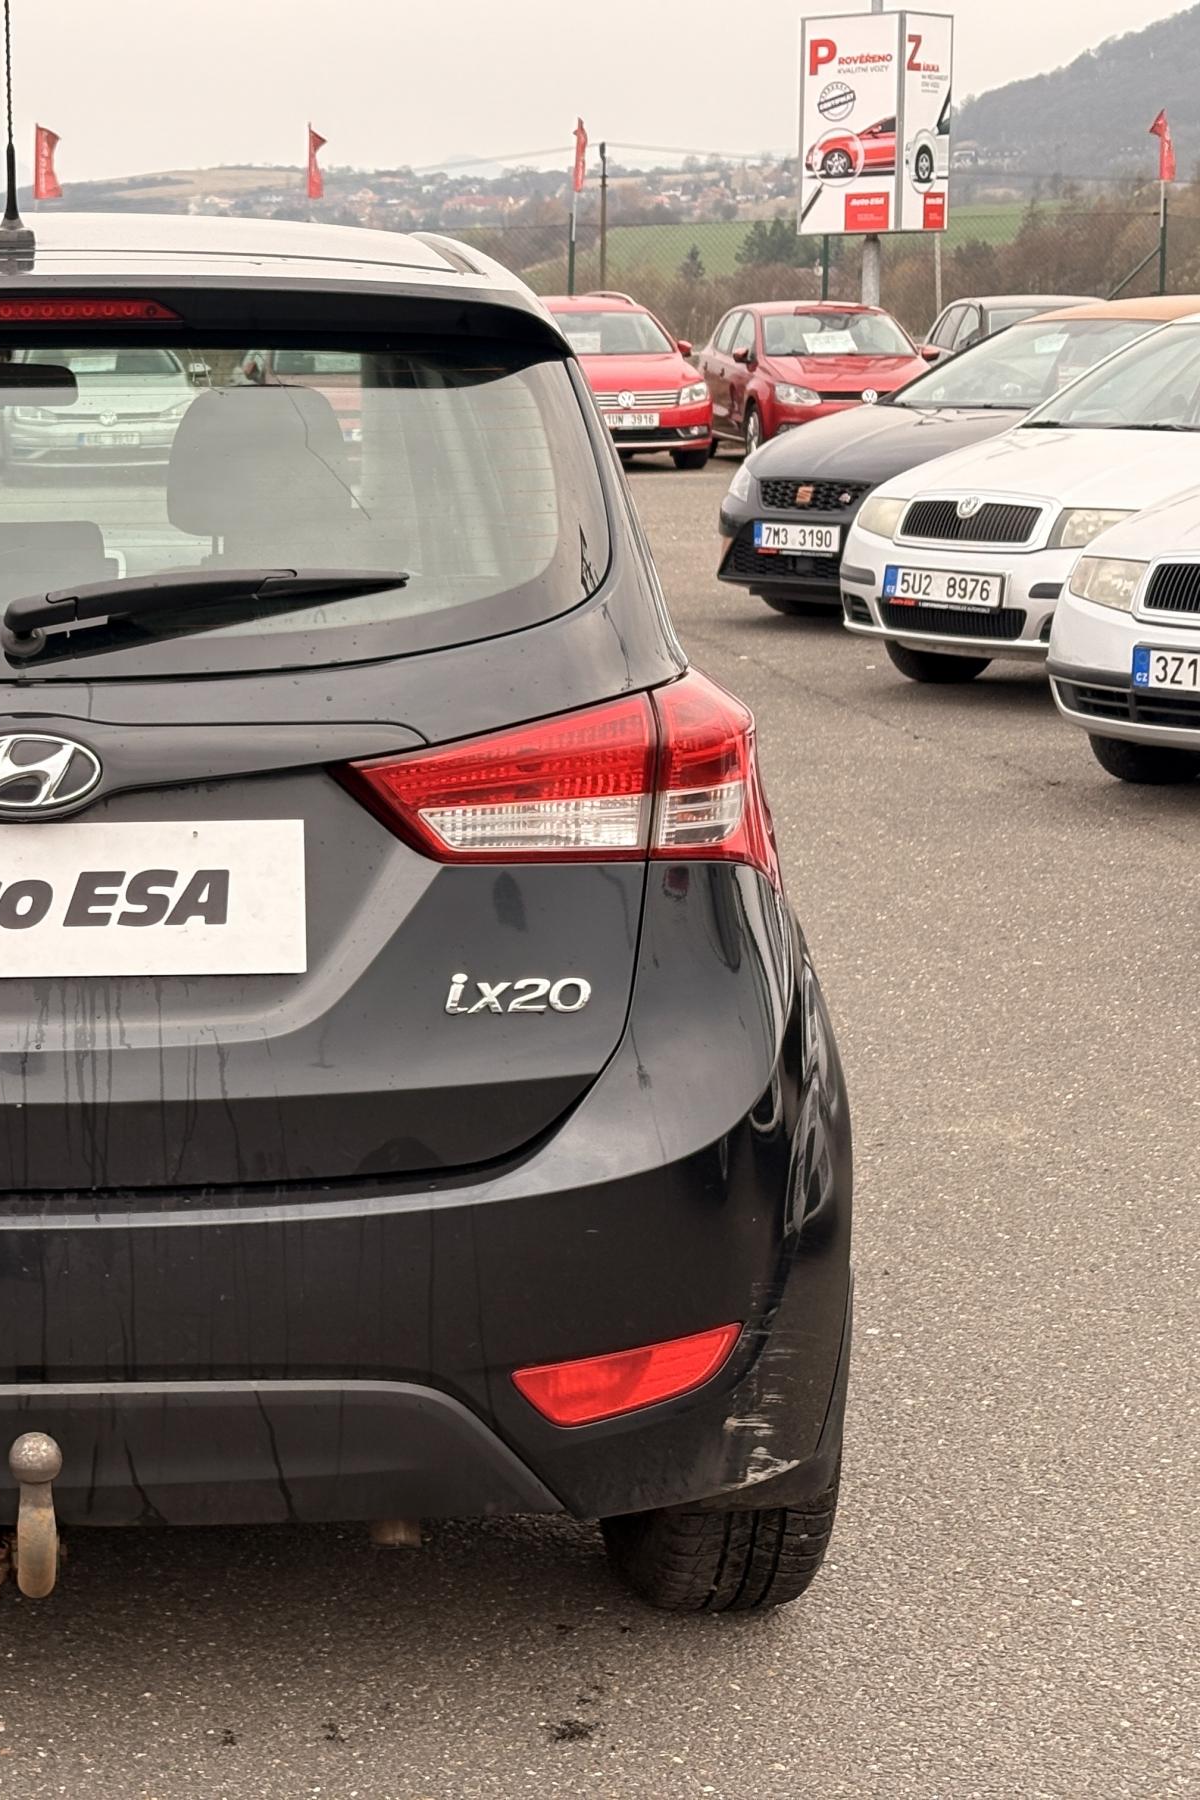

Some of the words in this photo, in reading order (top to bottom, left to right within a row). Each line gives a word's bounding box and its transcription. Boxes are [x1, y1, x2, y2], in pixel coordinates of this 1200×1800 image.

[631, 414, 654, 425] 3916
[765, 527, 788, 546] 7M3
[798, 529, 832, 548] 3190
[900, 572, 932, 596] 5U2
[945, 576, 991, 601] 8976
[1135, 672, 1148, 682] CZ
[1155, 656, 1198, 686] 3Z1
[62, 869, 230, 927] ESA
[445, 973, 592, 1014] ix20
